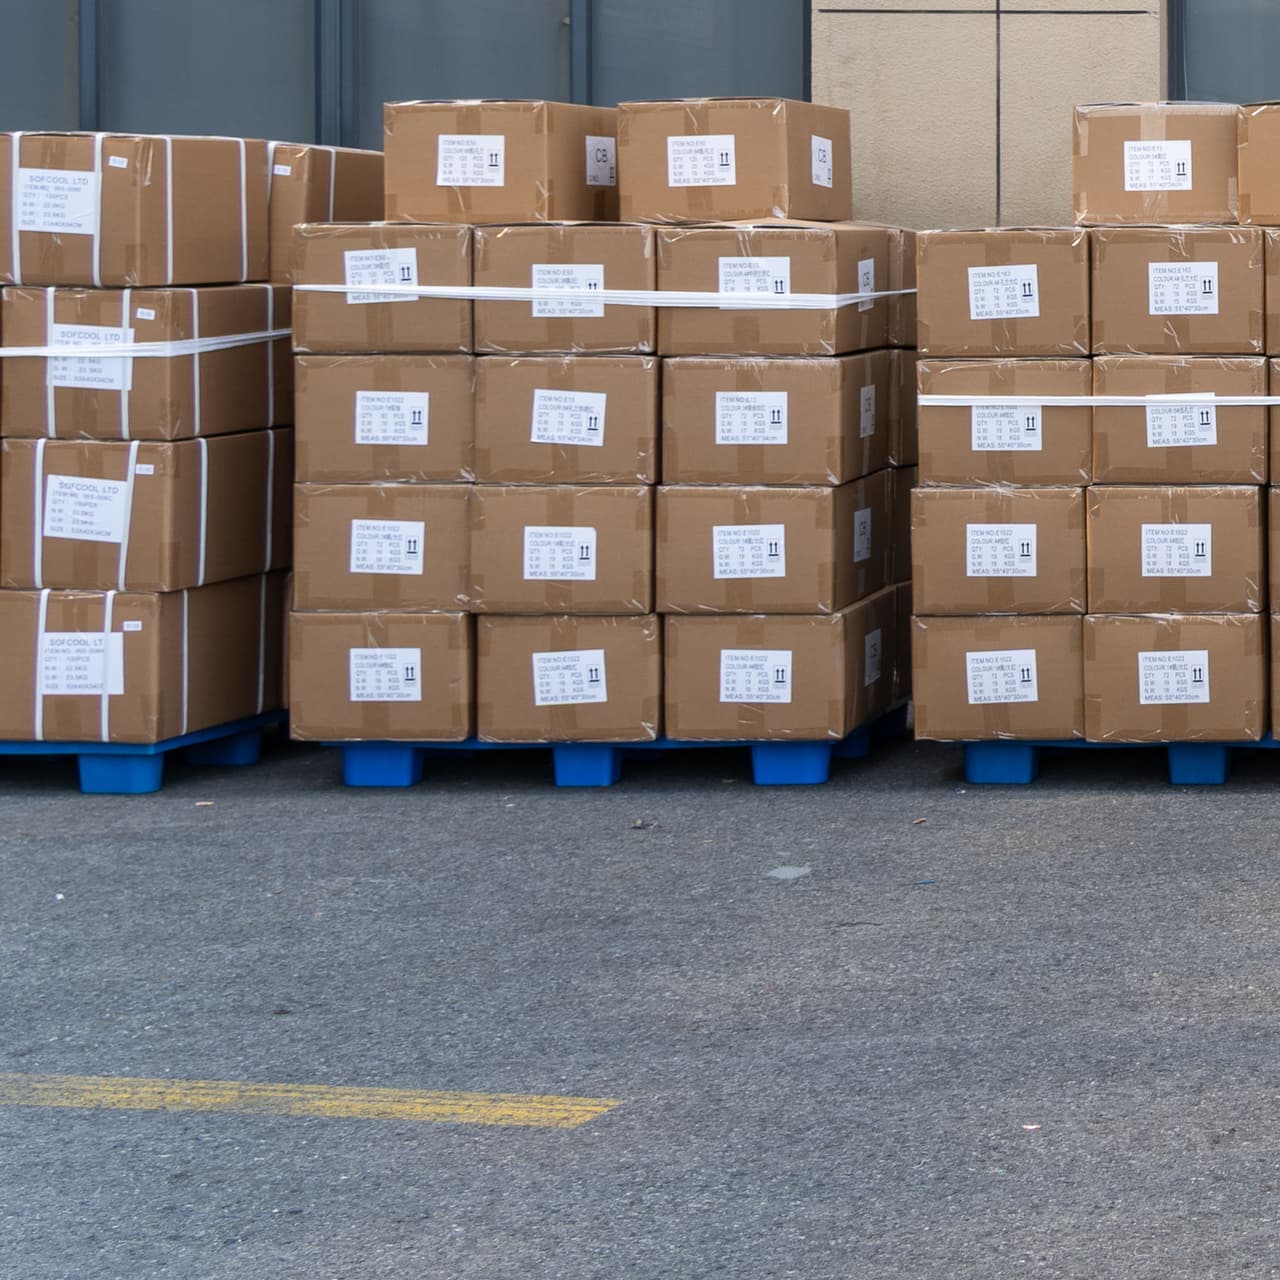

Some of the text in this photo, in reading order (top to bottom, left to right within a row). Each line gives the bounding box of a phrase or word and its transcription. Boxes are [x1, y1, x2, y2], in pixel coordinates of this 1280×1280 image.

[72, 177, 88, 185] LTD
[104, 333, 120, 341] LTD
[103, 486, 119, 494] LTD
